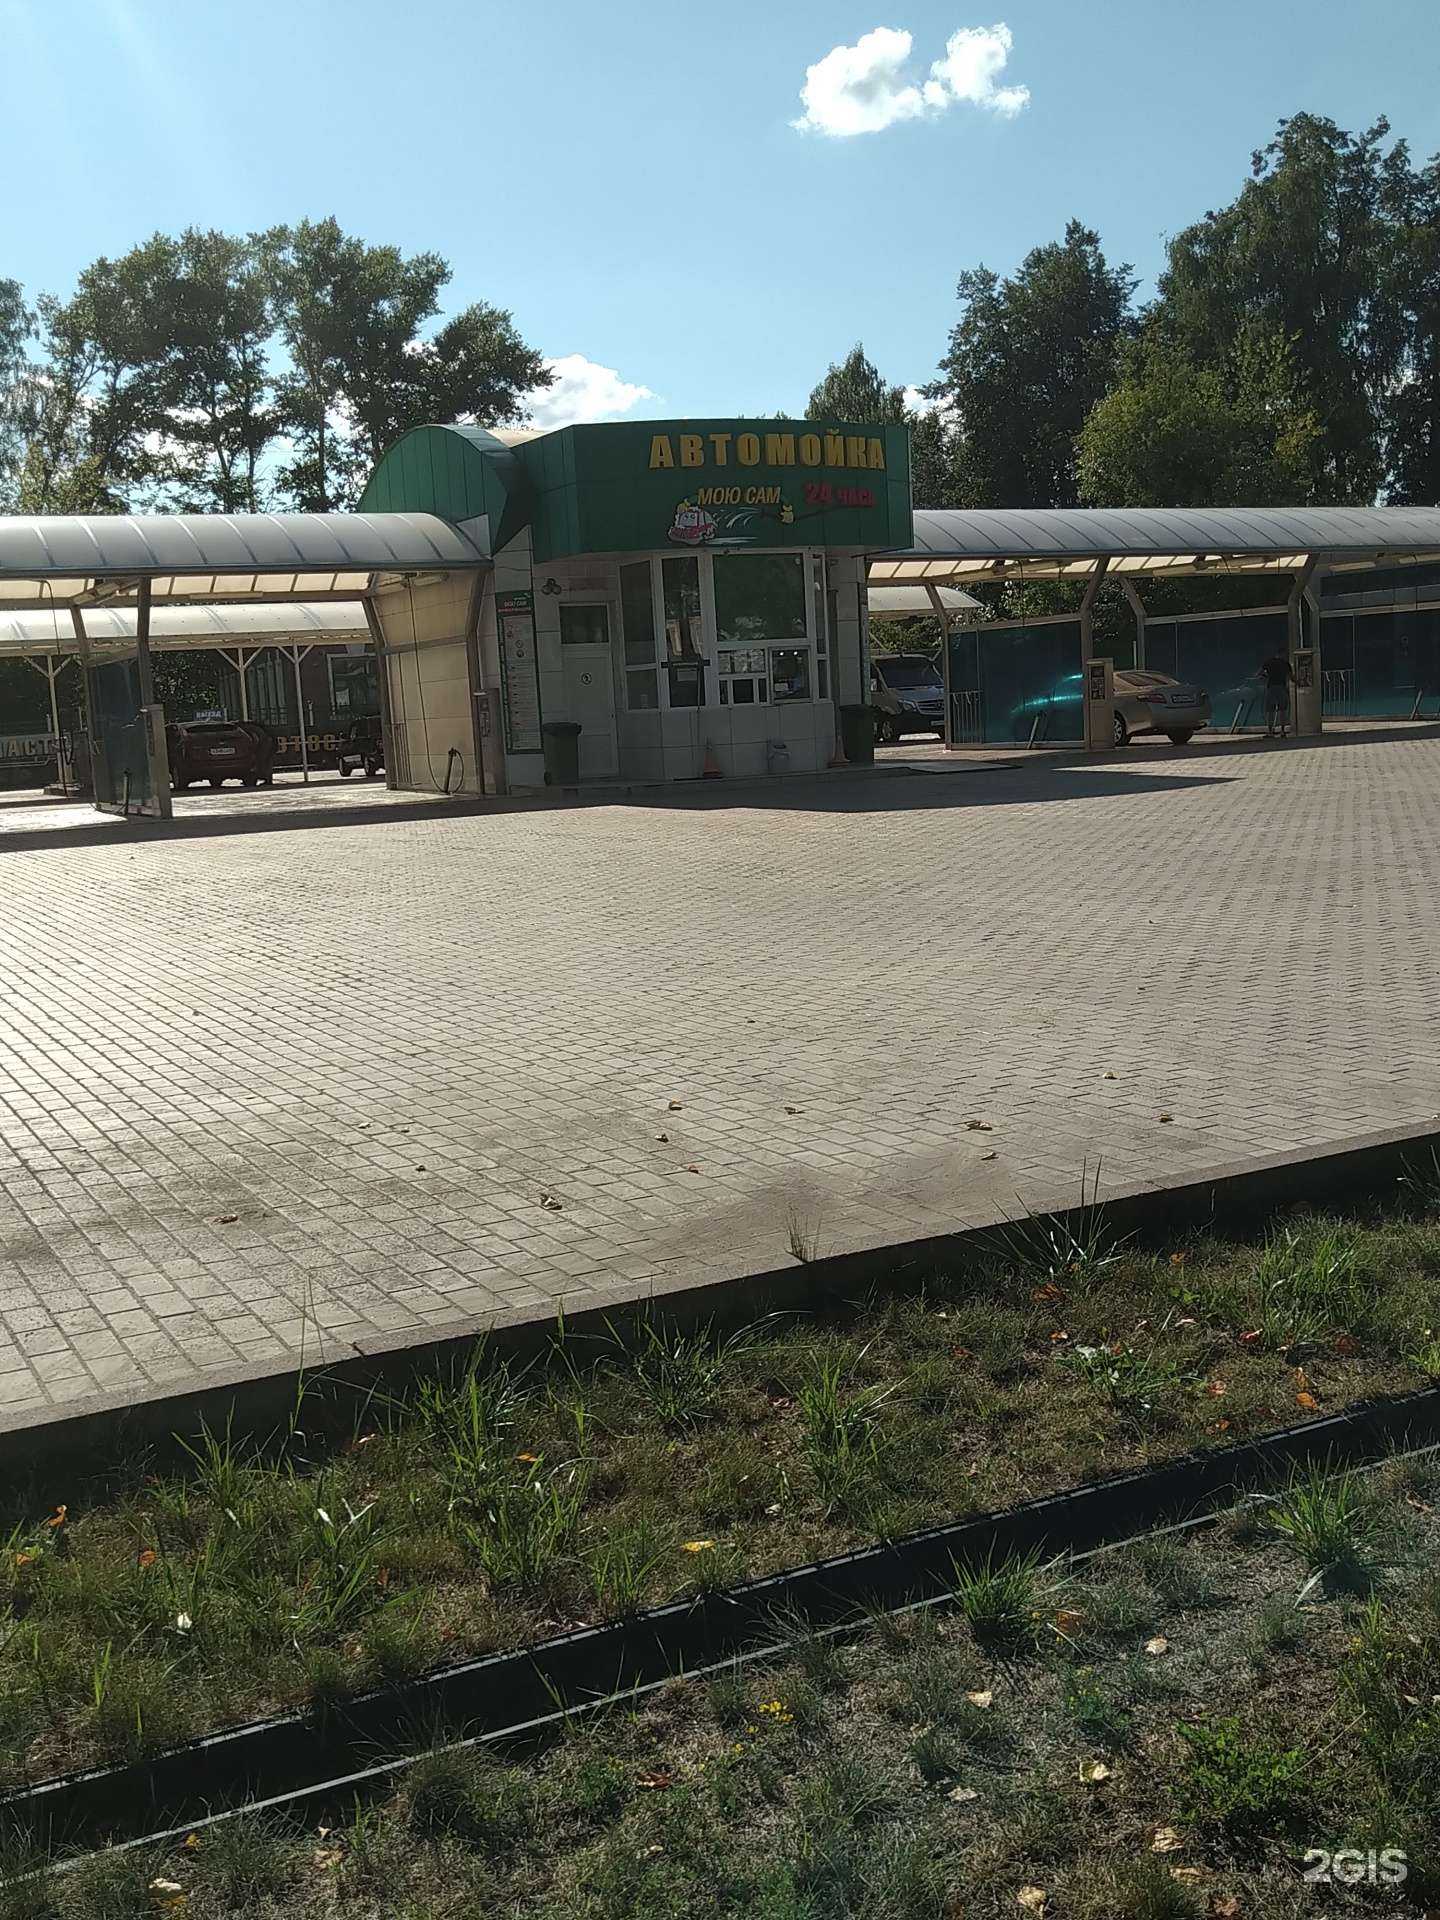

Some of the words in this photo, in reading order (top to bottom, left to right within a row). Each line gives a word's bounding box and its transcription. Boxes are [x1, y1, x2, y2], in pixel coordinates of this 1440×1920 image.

[648, 427, 886, 470] АВТОМОЙКА
[698, 487, 741, 505] МОЮ
[746, 486, 781, 504] САМ
[804, 481, 832, 504] 24
